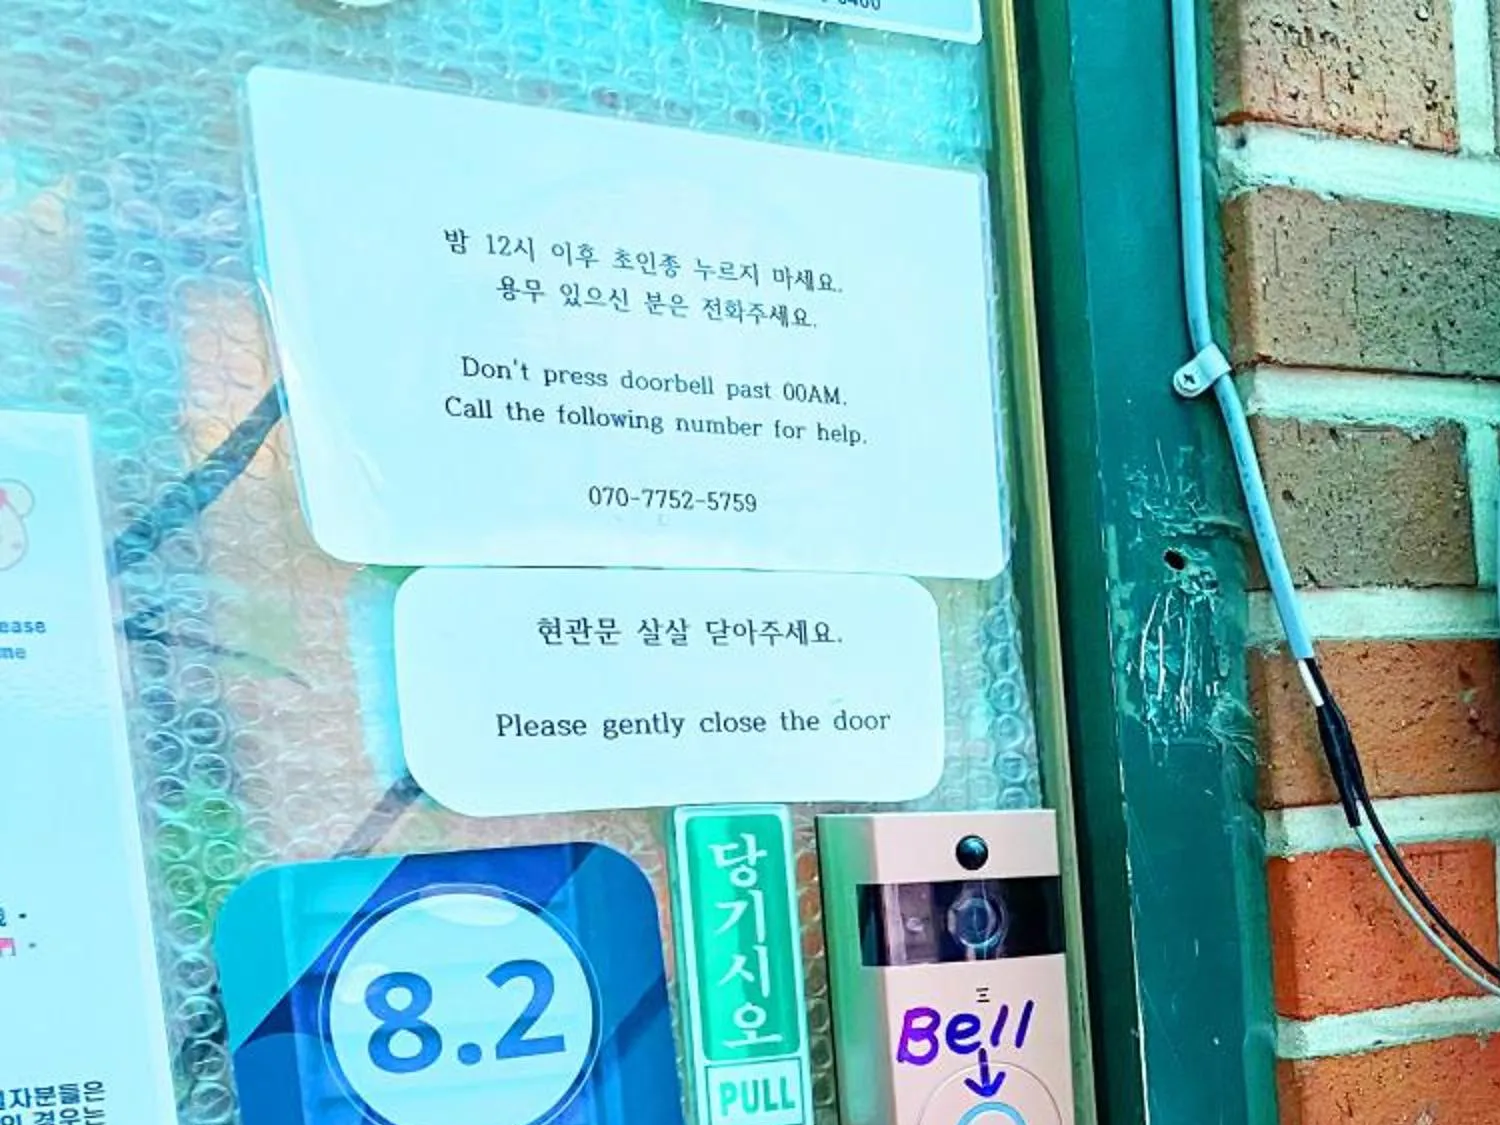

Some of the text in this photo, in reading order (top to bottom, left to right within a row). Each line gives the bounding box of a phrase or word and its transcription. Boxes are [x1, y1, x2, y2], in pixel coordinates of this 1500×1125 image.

[444, 228, 843, 293] 밤 12시 이후 초인종 누르지 마세요.
[496, 275, 817, 328] 용무 있으신 분은 전화주세요.
[461, 355, 848, 406] Don't press doorbell past 00AM.
[445, 395, 868, 447] Call the following number for help.
[588, 485, 757, 513] 070-7752-5759
[537, 616, 844, 648] 현관문 살살 닫아주세요.
[496, 709, 892, 740] Please gently close the door
[708, 834, 784, 1050] 당기시오
[363, 958, 566, 1075] 8.2
[897, 1000, 1034, 1067] Bell
[0, 1080, 106, 1111] 자분들은
[719, 1076, 797, 1117] PULL
